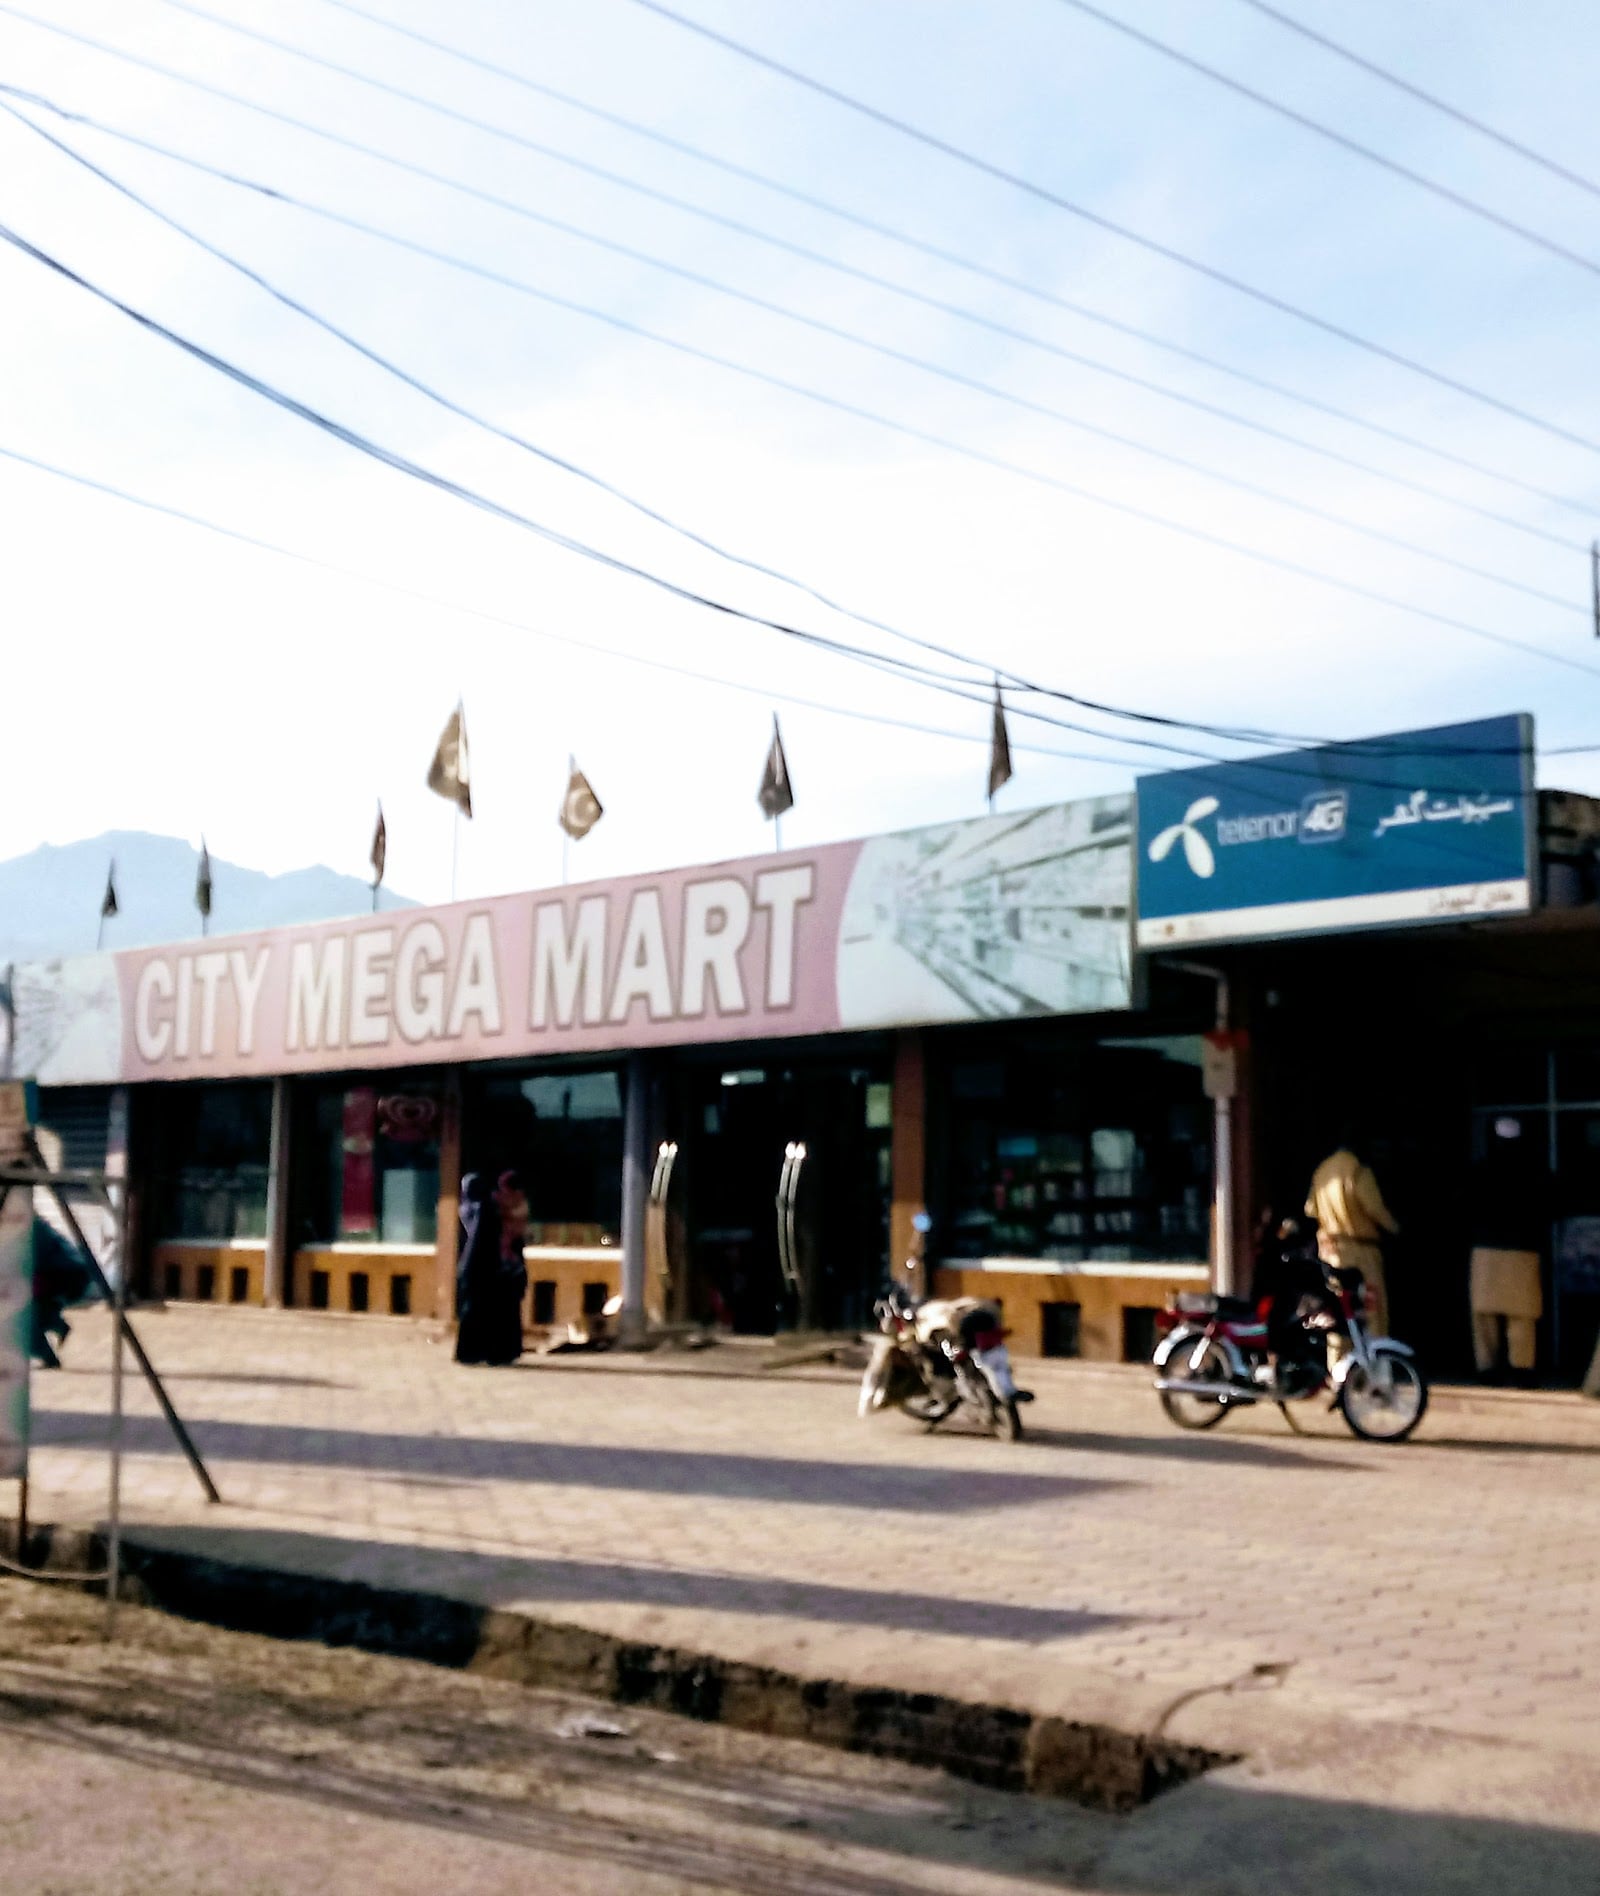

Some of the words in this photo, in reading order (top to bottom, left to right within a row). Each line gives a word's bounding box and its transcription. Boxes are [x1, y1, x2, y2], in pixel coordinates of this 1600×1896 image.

[1217, 811, 1298, 846] telenor
[1303, 799, 1345, 833] 4G
[134, 943, 273, 1063] CITY
[284, 910, 504, 1052] MEGA
[529, 863, 817, 1031] MART
